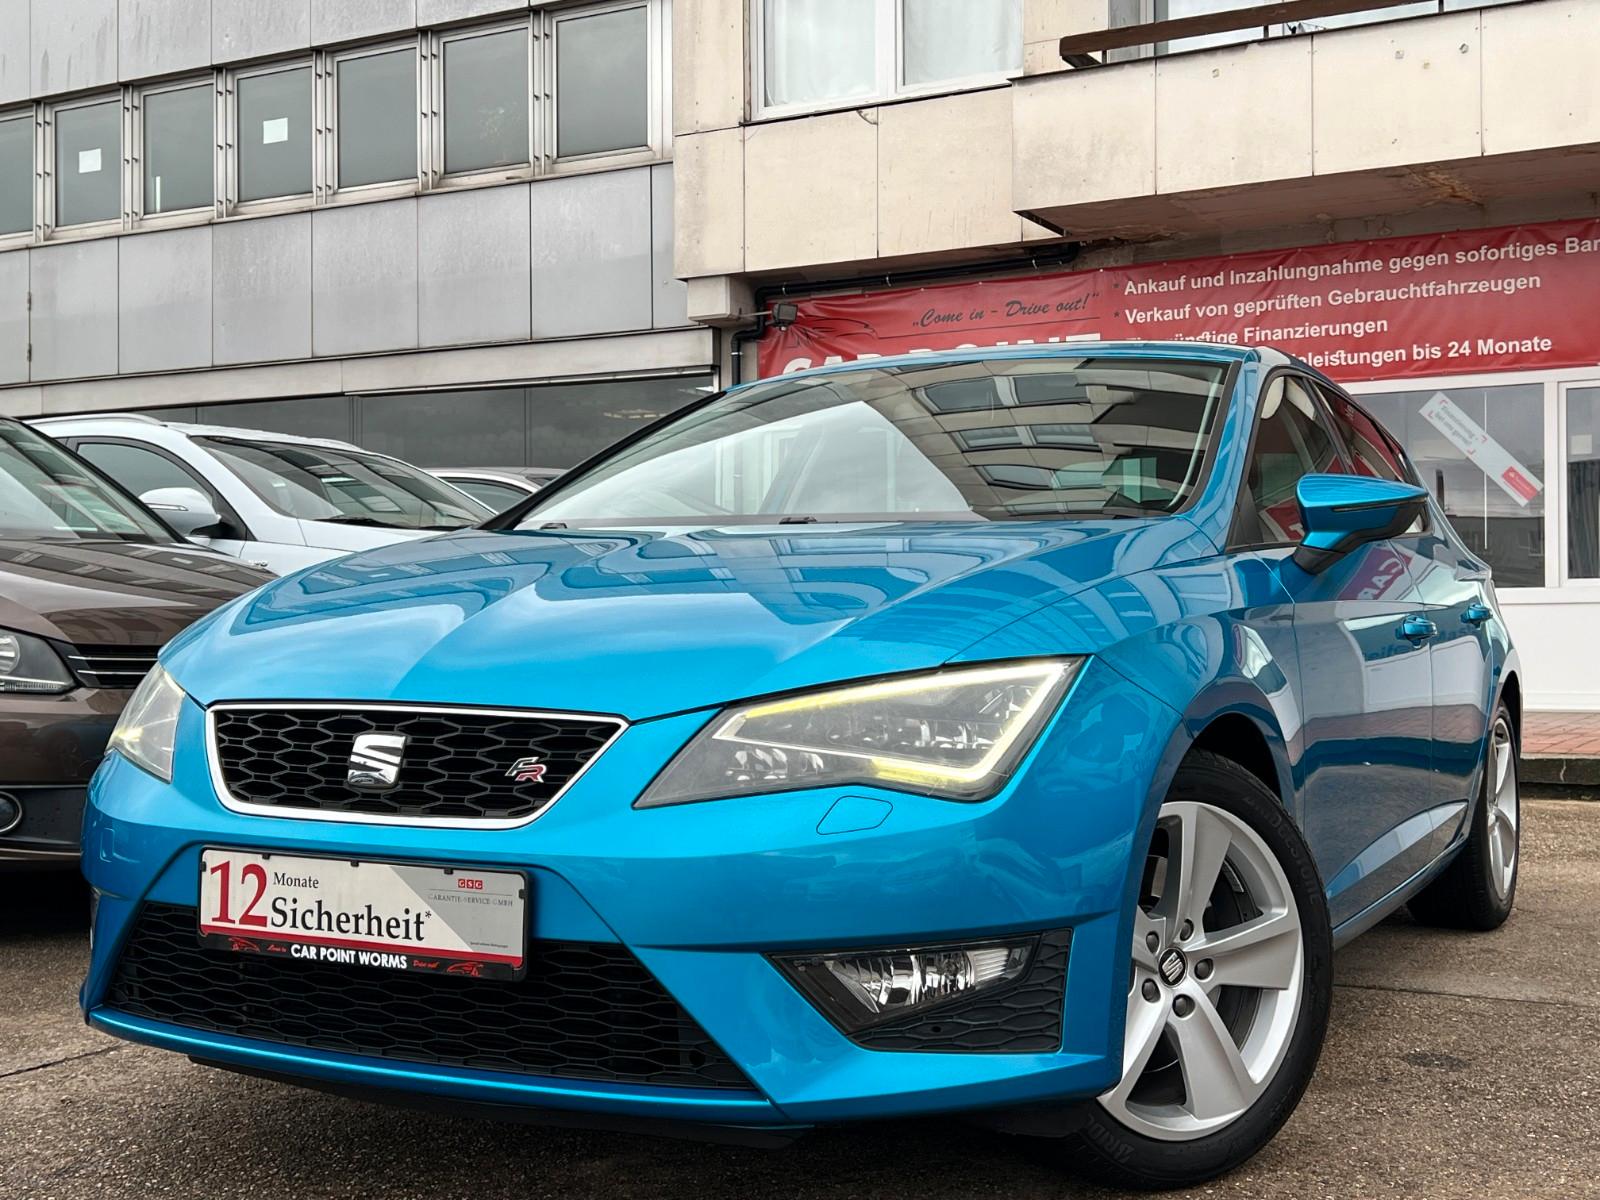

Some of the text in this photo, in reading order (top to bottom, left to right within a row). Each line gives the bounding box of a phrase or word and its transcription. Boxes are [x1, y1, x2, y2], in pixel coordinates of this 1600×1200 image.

[1124, 275, 1186, 295] Ankauf
[1191, 271, 1224, 289] und
[1230, 258, 1383, 286] Inzahlungnahme
[1389, 252, 1448, 274] gegen
[1455, 240, 1558, 264] sofortiges
[969, 307, 984, 322] in
[1006, 299, 1049, 318] Drive
[1125, 275, 1541, 324] Verkauf von geprüften Gebrauchtfahrzeugen
[1244, 319, 1388, 343] Finanzierungen
[1412, 343, 1442, 361] bis
[1447, 340, 1471, 358] 24
[1477, 335, 1552, 356] Monate
[210, 860, 320, 927] 12 Monate
[458, 879, 483, 889] GSG
[291, 944, 317, 960] CAR
[320, 946, 357, 964] POINT
[359, 952, 408, 969] WORMS
